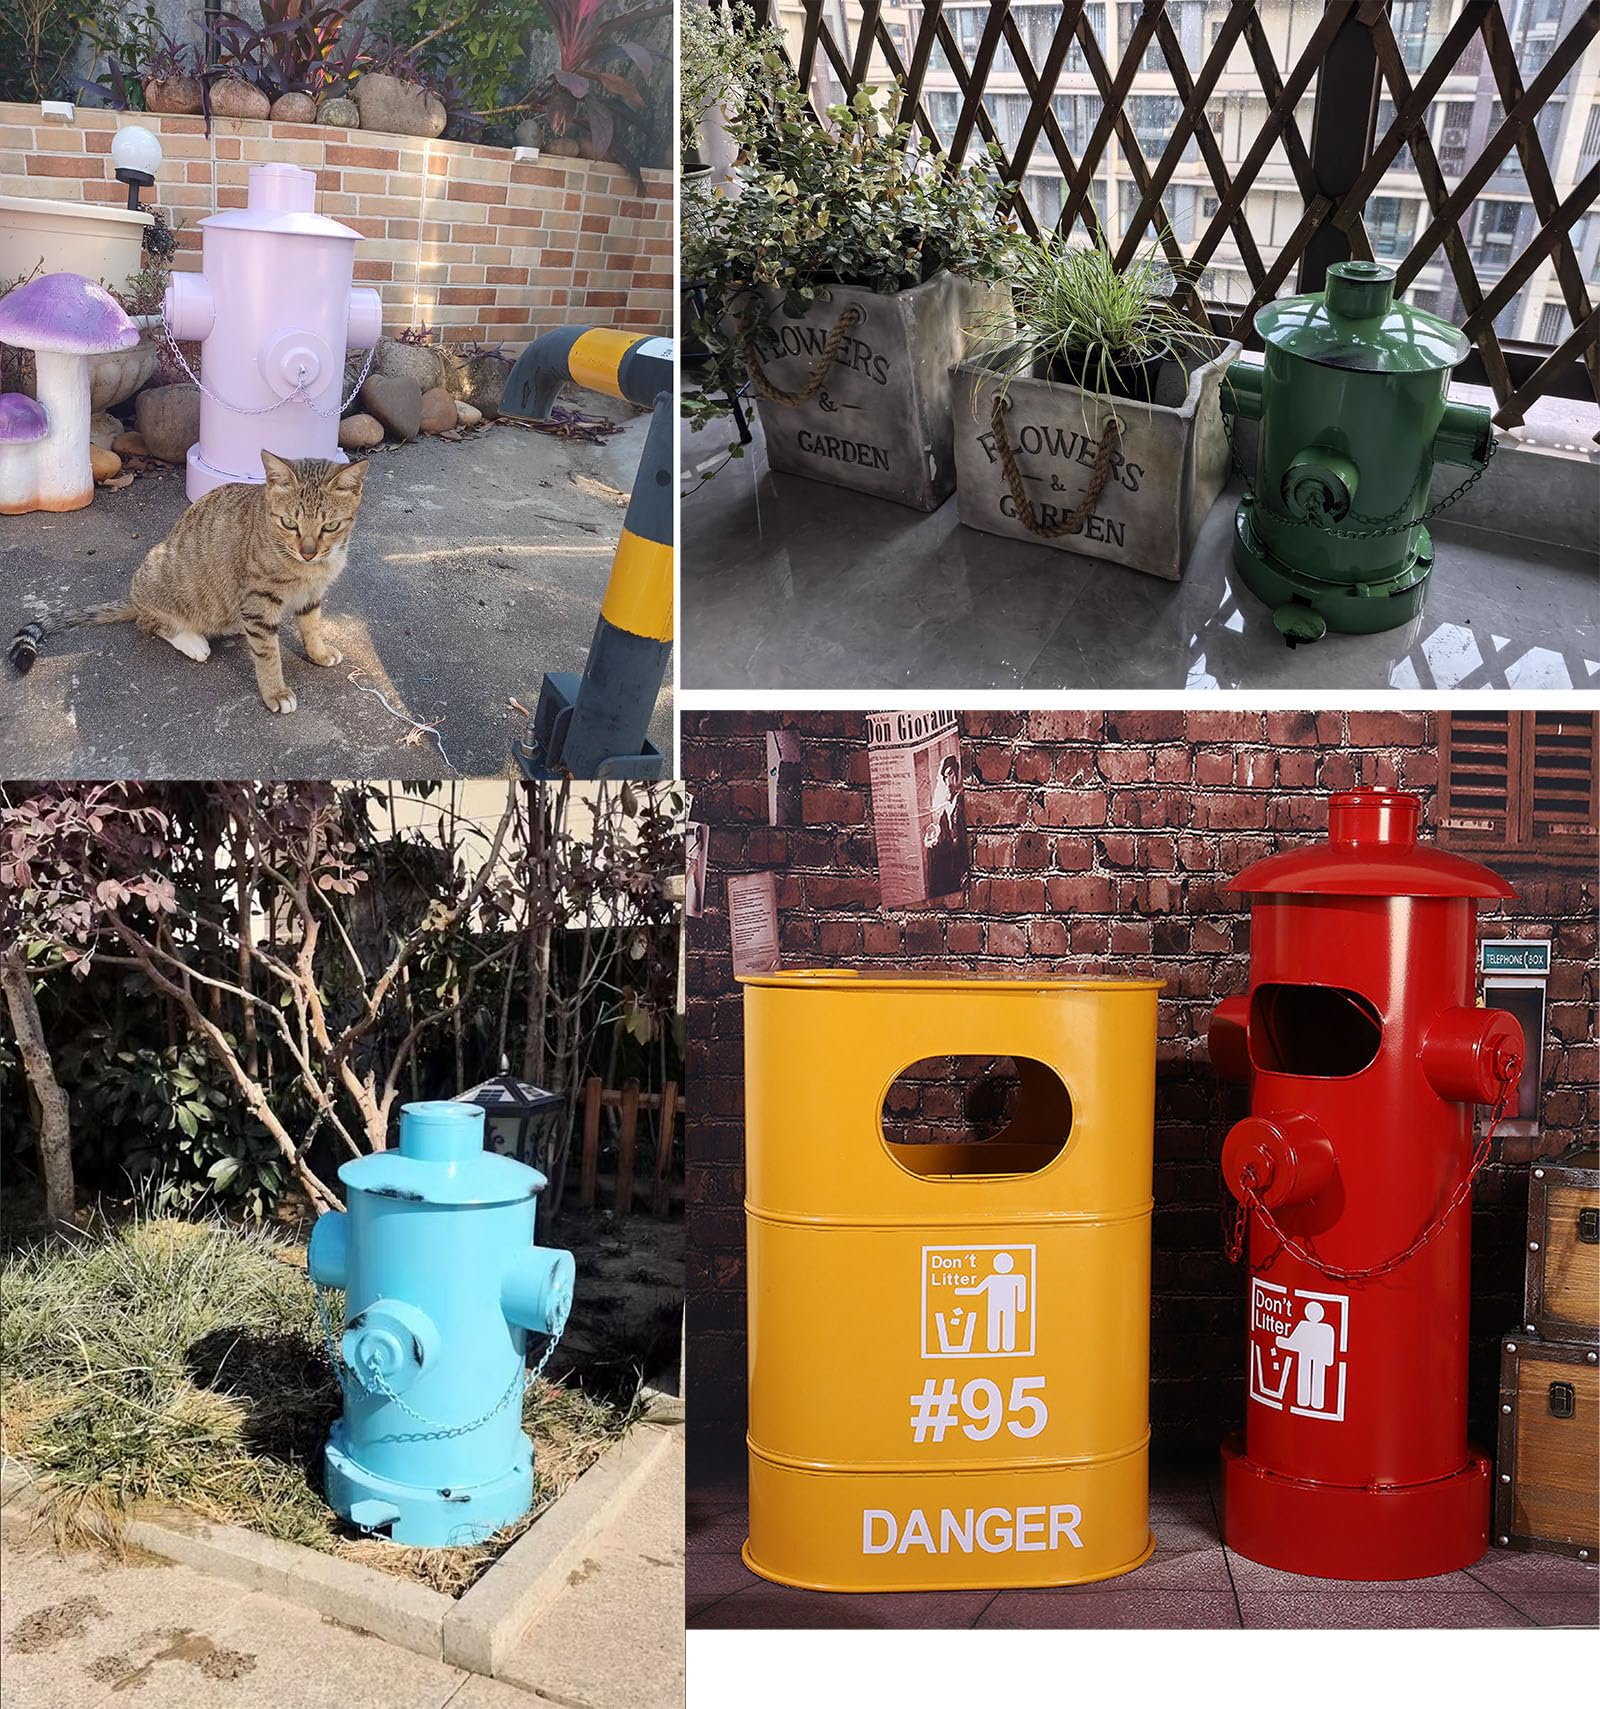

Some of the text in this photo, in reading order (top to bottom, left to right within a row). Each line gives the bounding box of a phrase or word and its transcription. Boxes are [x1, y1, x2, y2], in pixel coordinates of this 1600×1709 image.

[818, 391, 838, 412] &
[797, 430, 890, 471] GARDEN
[1050, 474, 1067, 492] &
[867, 718, 892, 744] Don
[1486, 953, 1545, 965] TELEPHONE BOX
[931, 1272, 977, 1287] Litter
[1256, 1289, 1292, 1317] Don't
[1255, 1309, 1292, 1336] Litter
[909, 1375, 1050, 1443] #95
[862, 1503, 1085, 1555] DANGER
